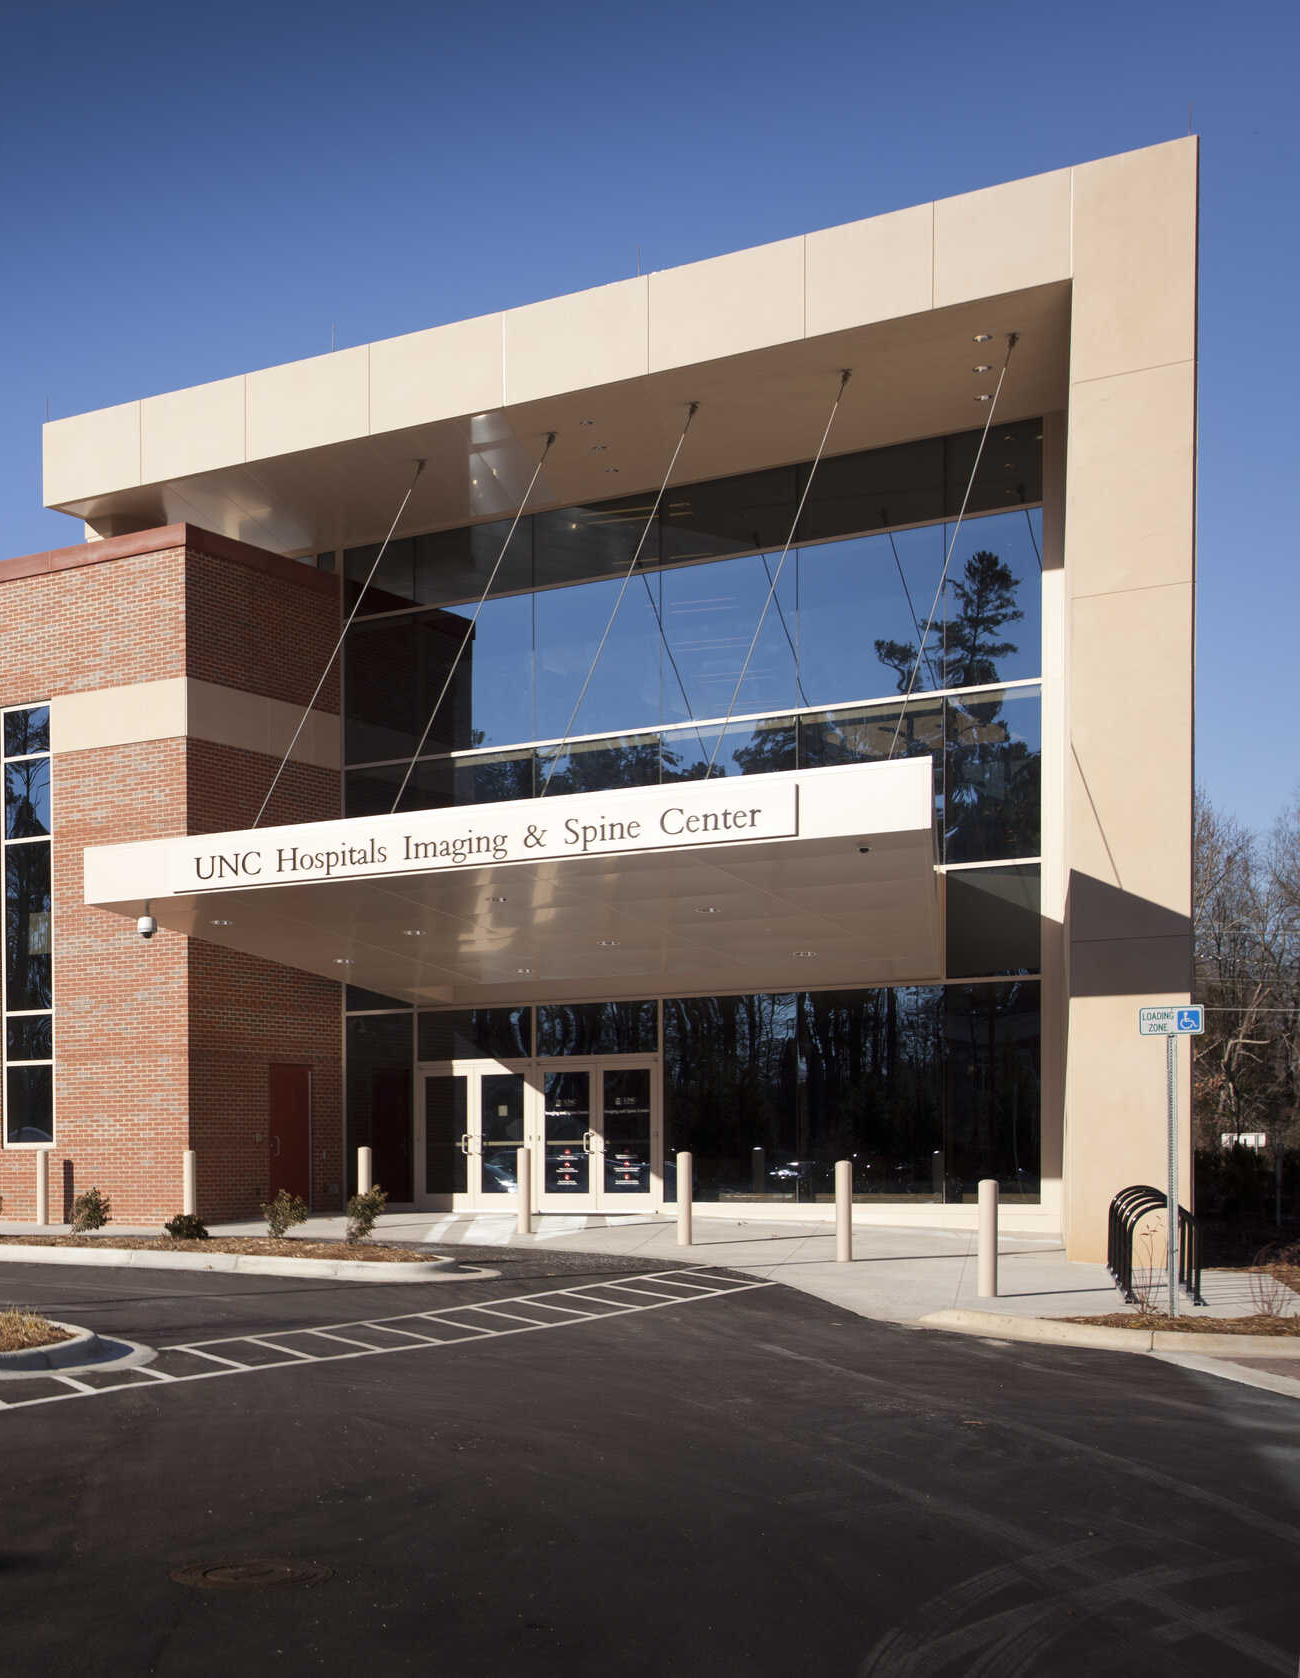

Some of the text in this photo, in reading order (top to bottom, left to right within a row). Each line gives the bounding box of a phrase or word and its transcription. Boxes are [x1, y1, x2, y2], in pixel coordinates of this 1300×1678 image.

[194, 806, 762, 880] UNC Hospitals Imaging & Spine Center
[1142, 1012, 1174, 1021] LOADING
[1148, 1023, 1168, 1033] ZONE
